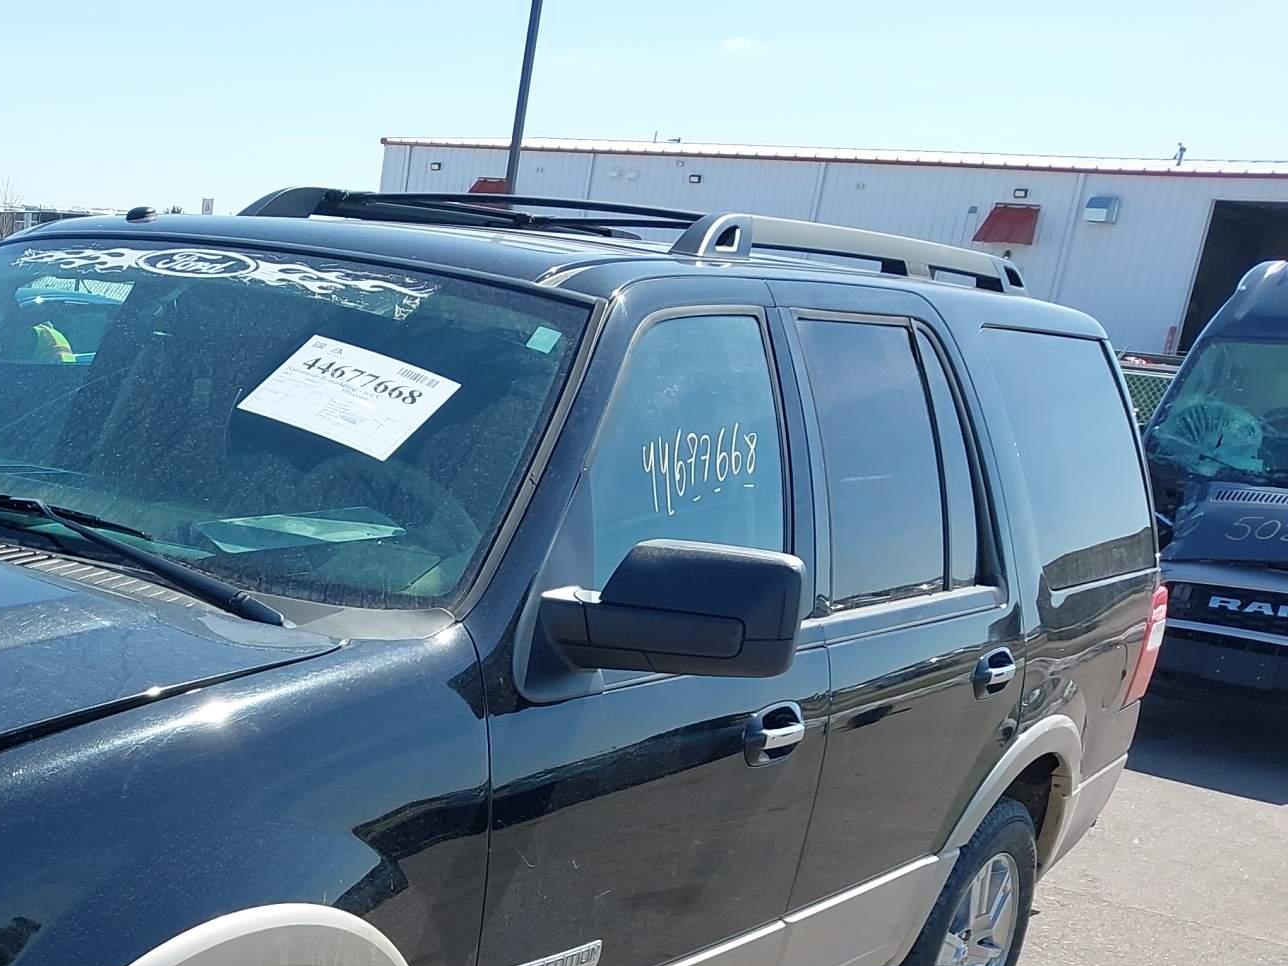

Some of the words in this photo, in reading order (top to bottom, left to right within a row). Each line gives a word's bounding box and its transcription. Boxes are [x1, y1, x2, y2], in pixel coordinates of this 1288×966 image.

[155, 252, 238, 274] Ford
[302, 357, 423, 405] 44677668
[643, 422, 758, 516] 44677668
[1208, 596, 1288, 618] RA
